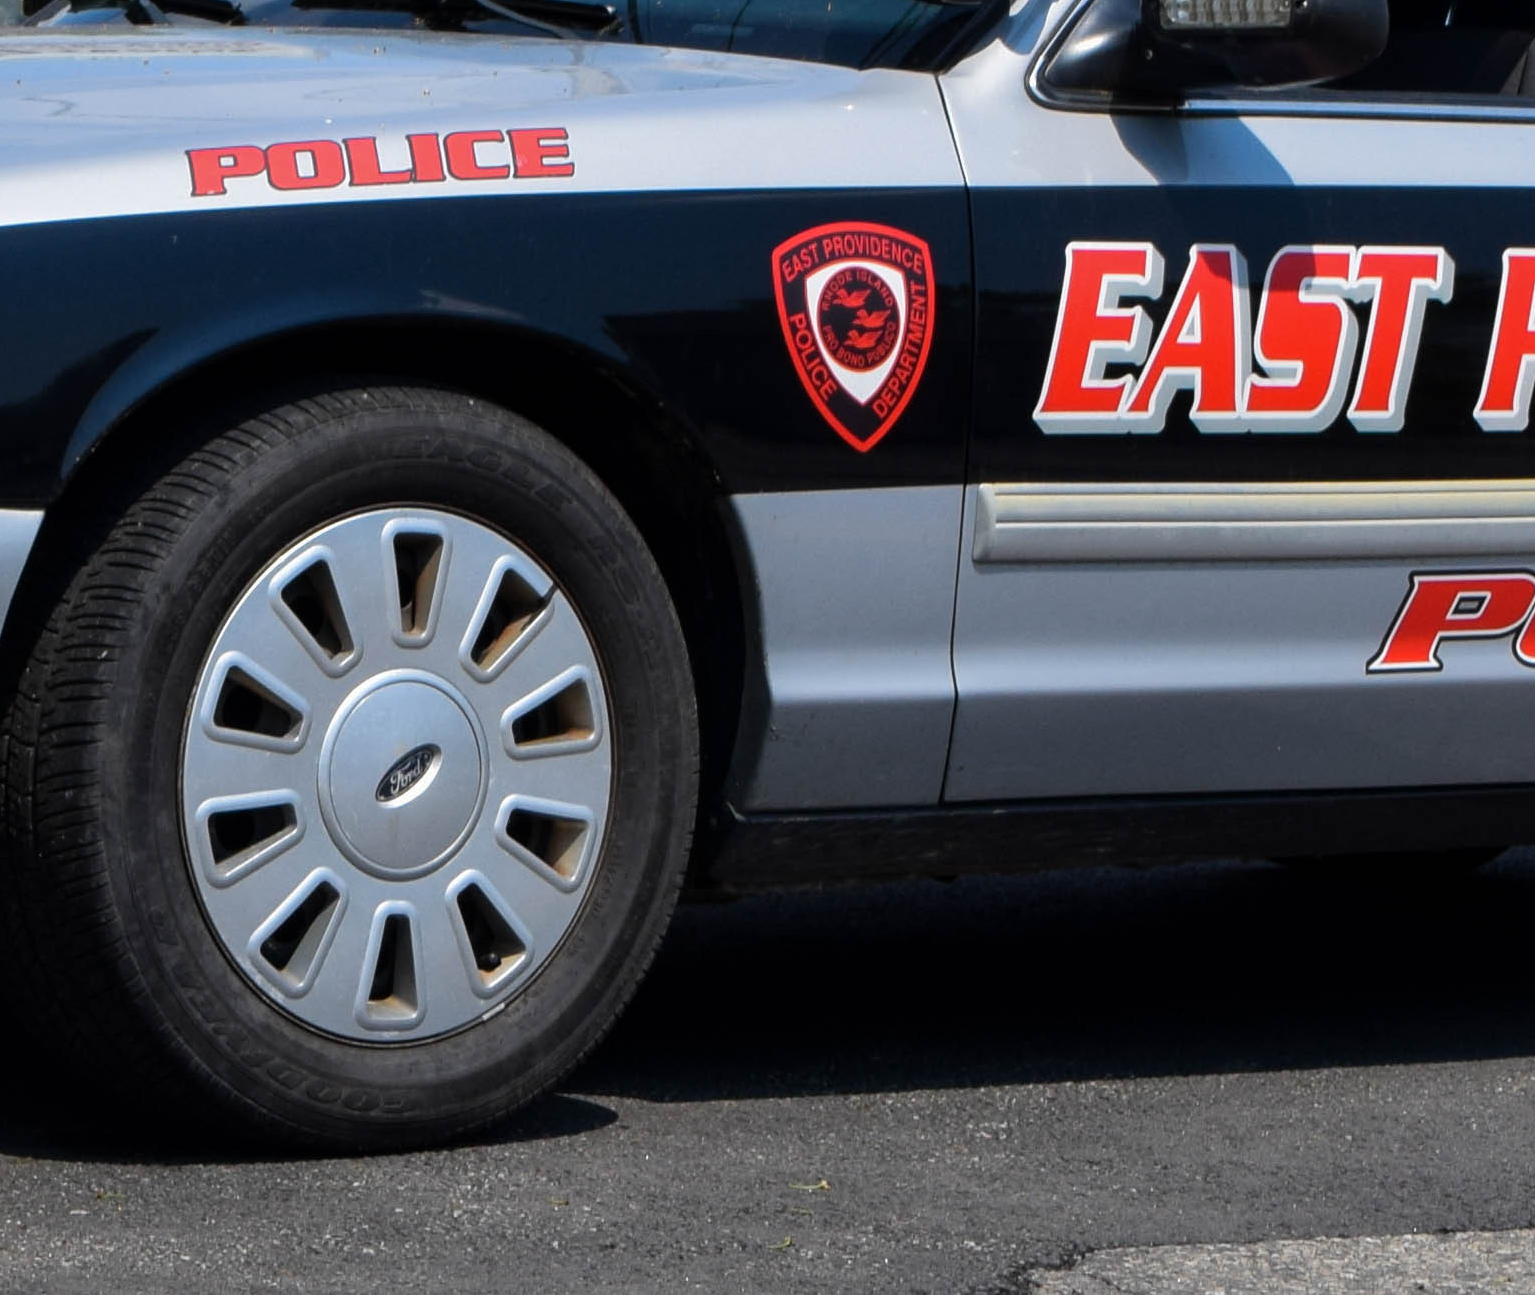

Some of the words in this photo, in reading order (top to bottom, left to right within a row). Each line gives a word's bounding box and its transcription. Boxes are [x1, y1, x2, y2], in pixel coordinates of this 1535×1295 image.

[184, 127, 575, 197] POLICE
[782, 243, 819, 282] EAST
[822, 234, 925, 275] PROVIDENCE
[821, 270, 853, 311] RHODE
[856, 270, 894, 307] ISLAND
[790, 313, 838, 402] POLICE
[872, 280, 926, 420] DEPARTMENT
[1032, 241, 1455, 435] EAST
[390, 757, 422, 795] Ford
